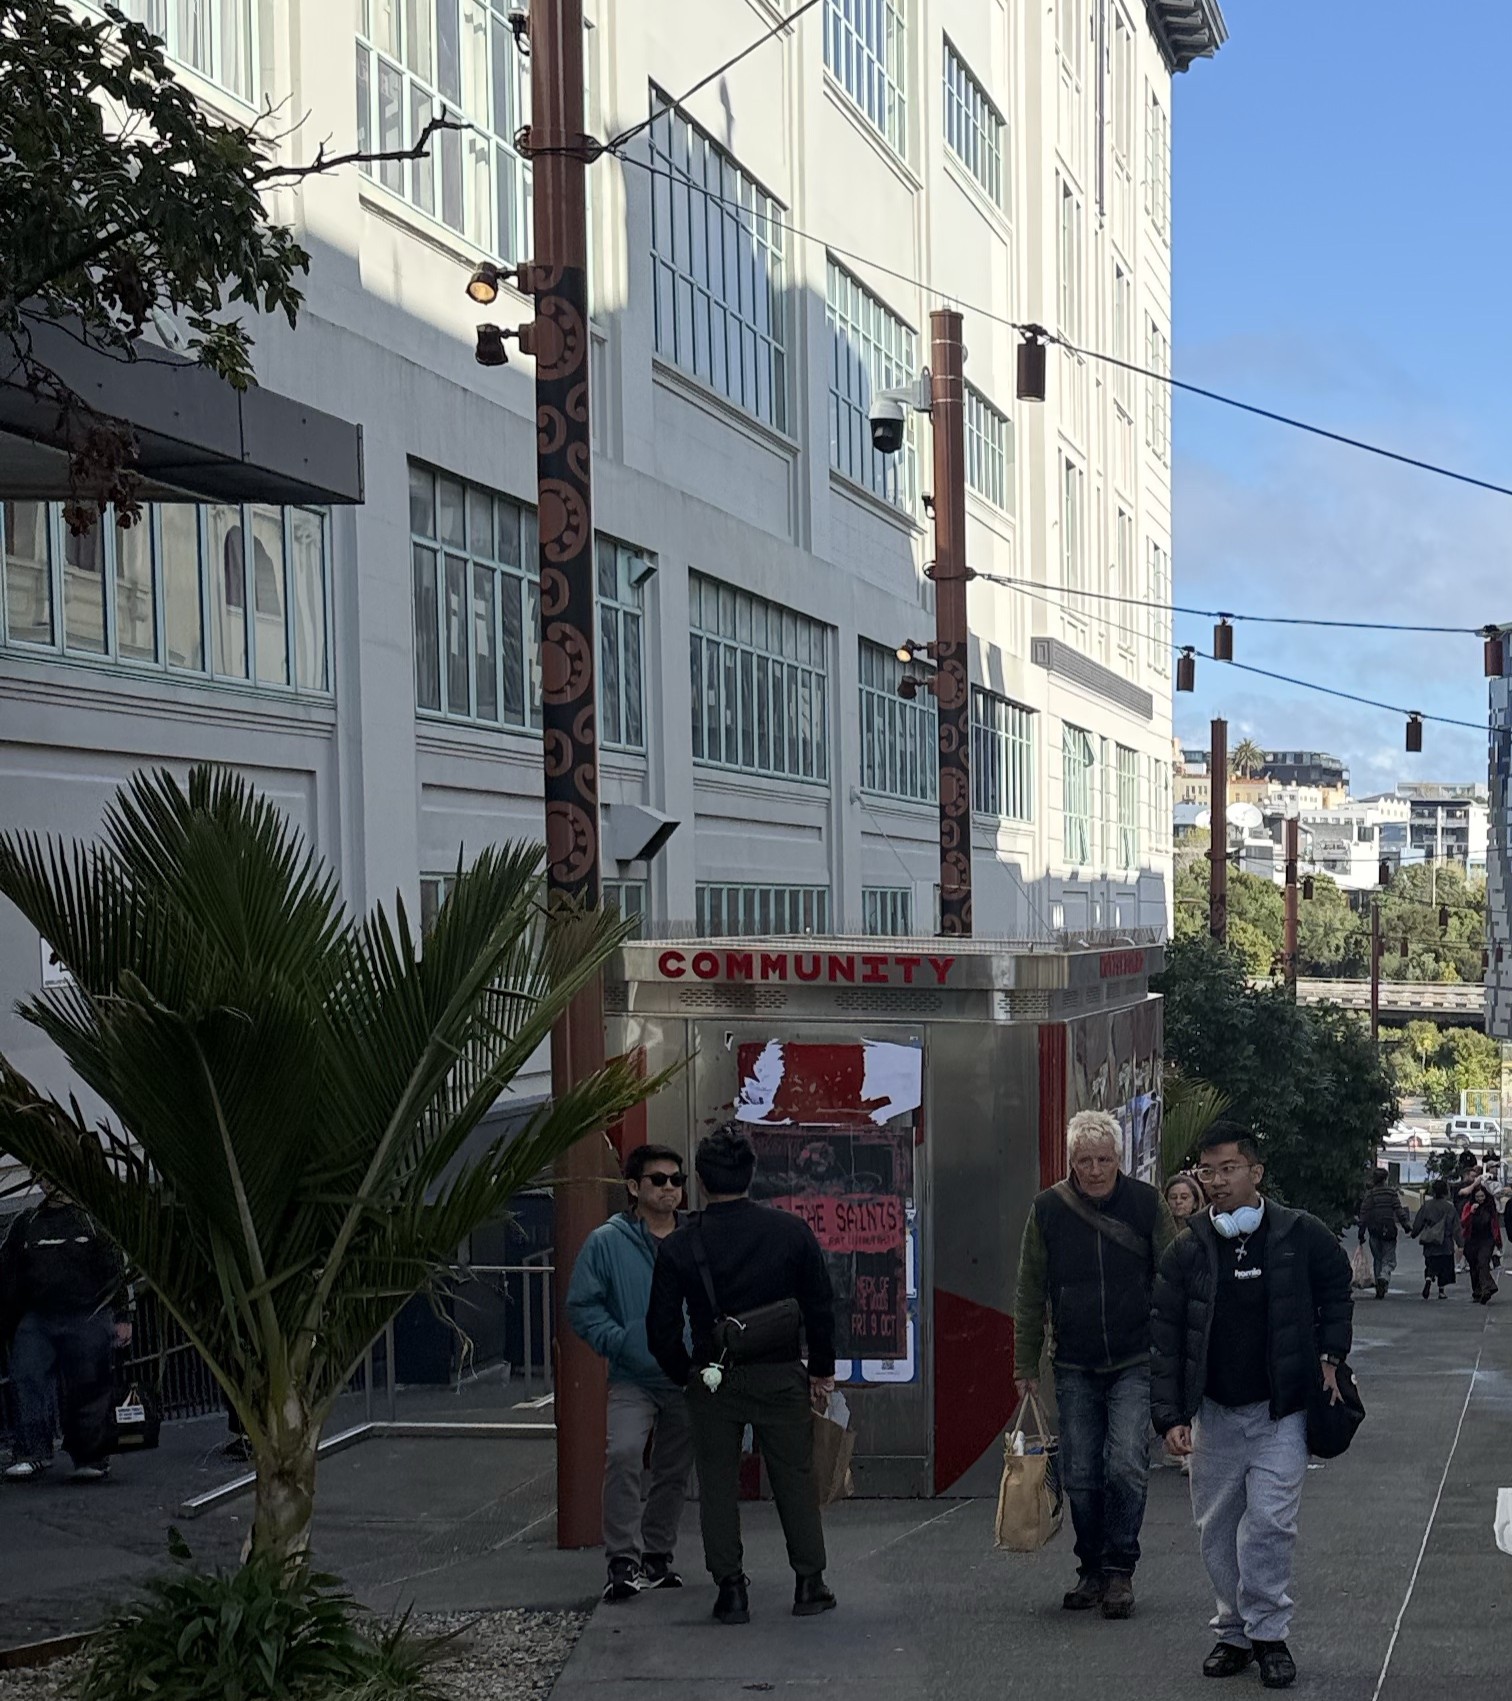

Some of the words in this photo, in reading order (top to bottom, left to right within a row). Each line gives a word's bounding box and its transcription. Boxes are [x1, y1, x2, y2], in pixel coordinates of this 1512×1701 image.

[658, 950, 956, 985] COMMUNITY
[835, 1202, 897, 1232] SAINTS
[851, 1313, 867, 1337] FRI
[870, 1313, 878, 1337] 9
[880, 1314, 897, 1337] OCT
